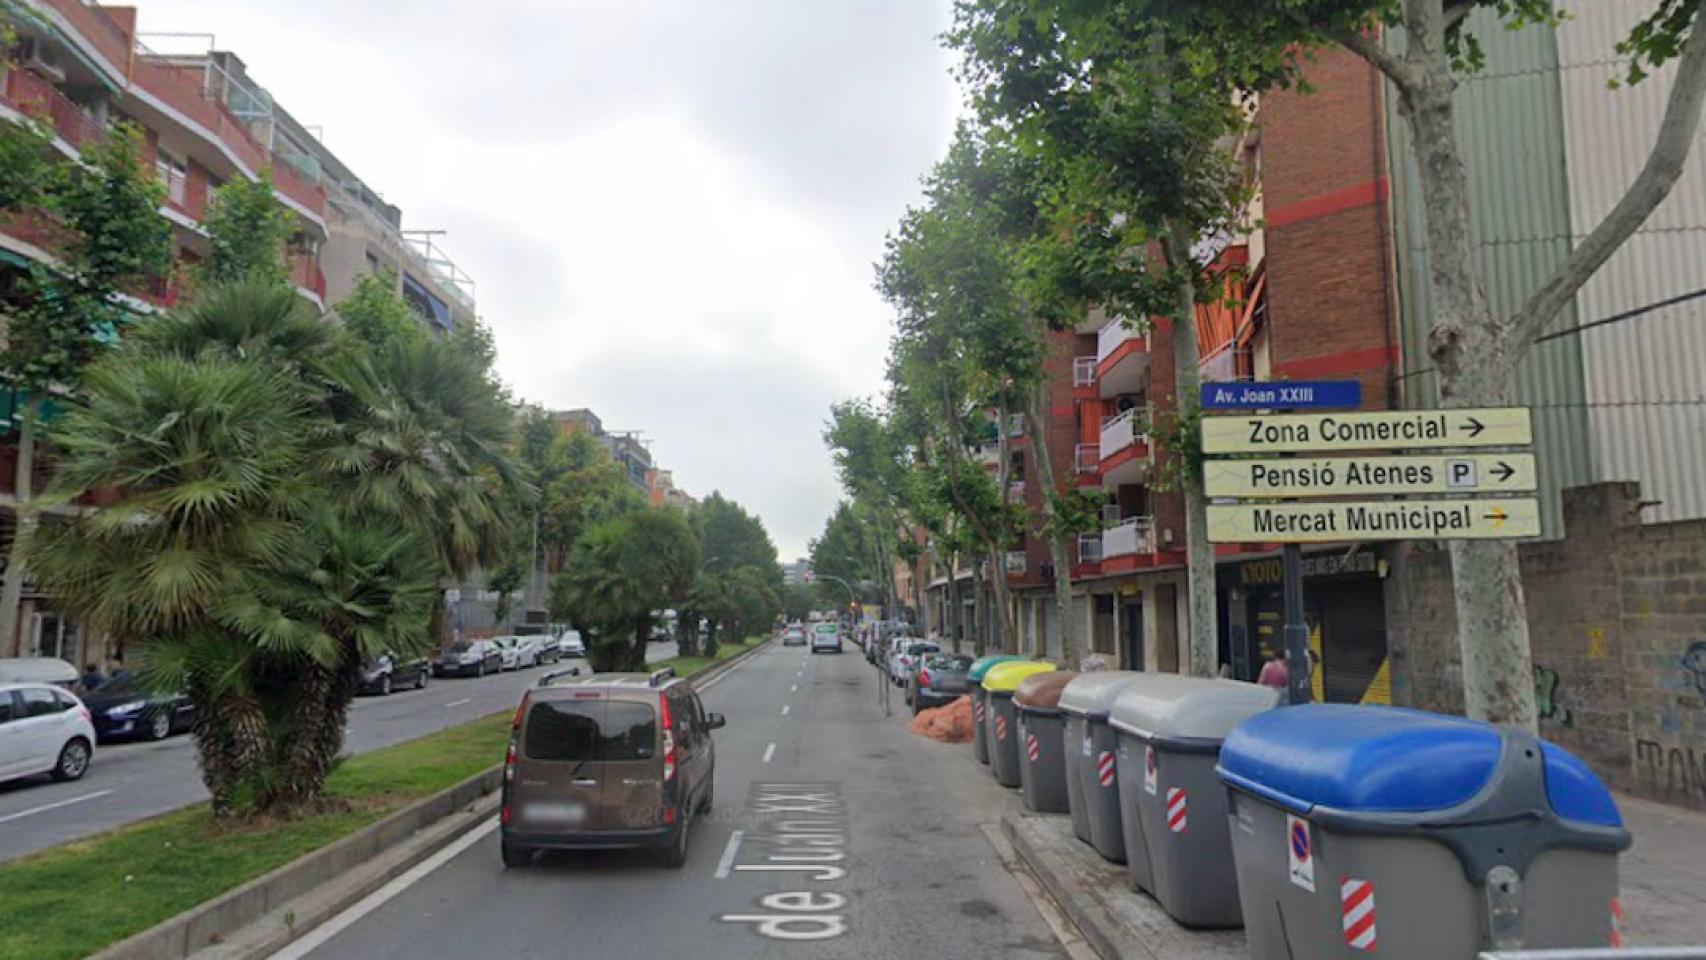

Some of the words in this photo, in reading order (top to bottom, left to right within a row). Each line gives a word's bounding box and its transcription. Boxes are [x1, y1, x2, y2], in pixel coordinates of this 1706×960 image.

[1215, 388, 1236, 403] Av.
[1240, 388, 1275, 403] Joan
[1280, 387, 1313, 403] XXIII
[1249, 420, 1309, 443] Zona
[1319, 416, 1447, 442] Comercial
[1251, 462, 1336, 487] Pensió
[1346, 461, 1434, 485] Atenes
[1453, 464, 1469, 482] P
[1253, 508, 1336, 532] Mercat
[1347, 505, 1471, 535] Municipal
